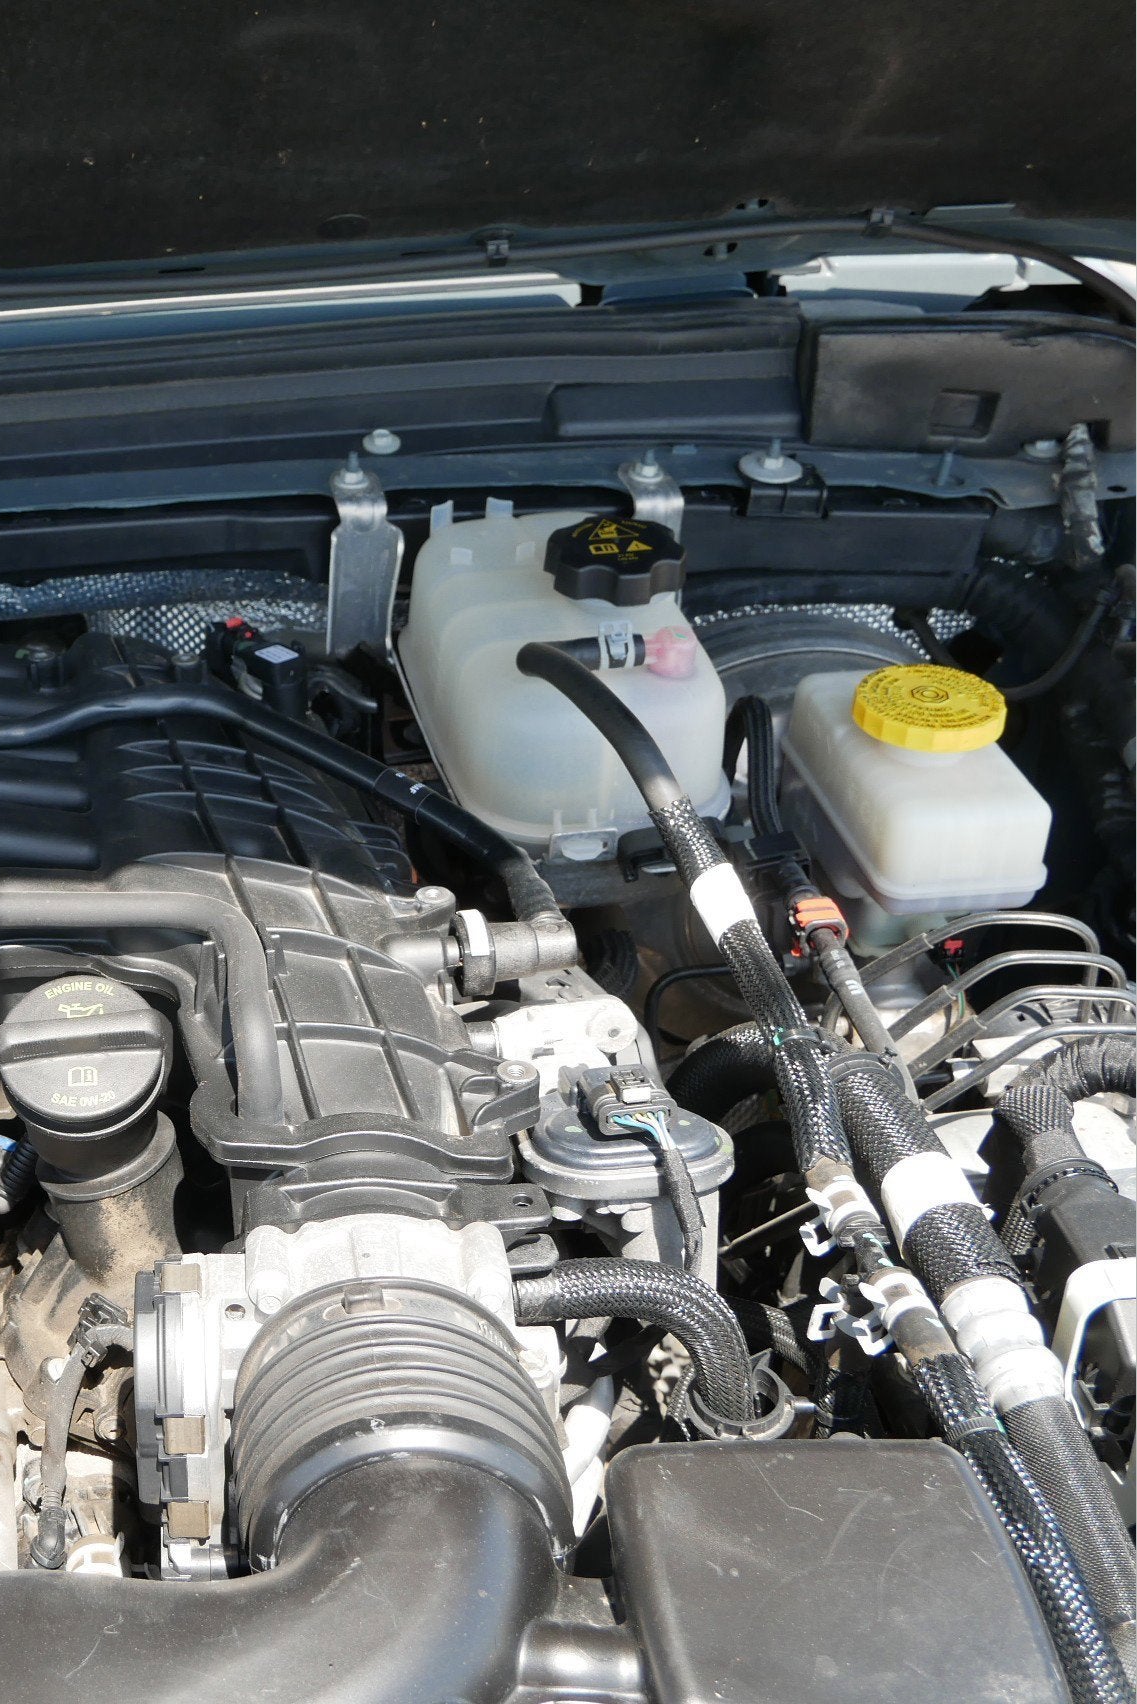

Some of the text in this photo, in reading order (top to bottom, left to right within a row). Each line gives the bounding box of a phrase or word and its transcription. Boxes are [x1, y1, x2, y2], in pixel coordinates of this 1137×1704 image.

[45, 982, 115, 1000] ENGINE OIL
[51, 1093, 77, 1107] SAE
